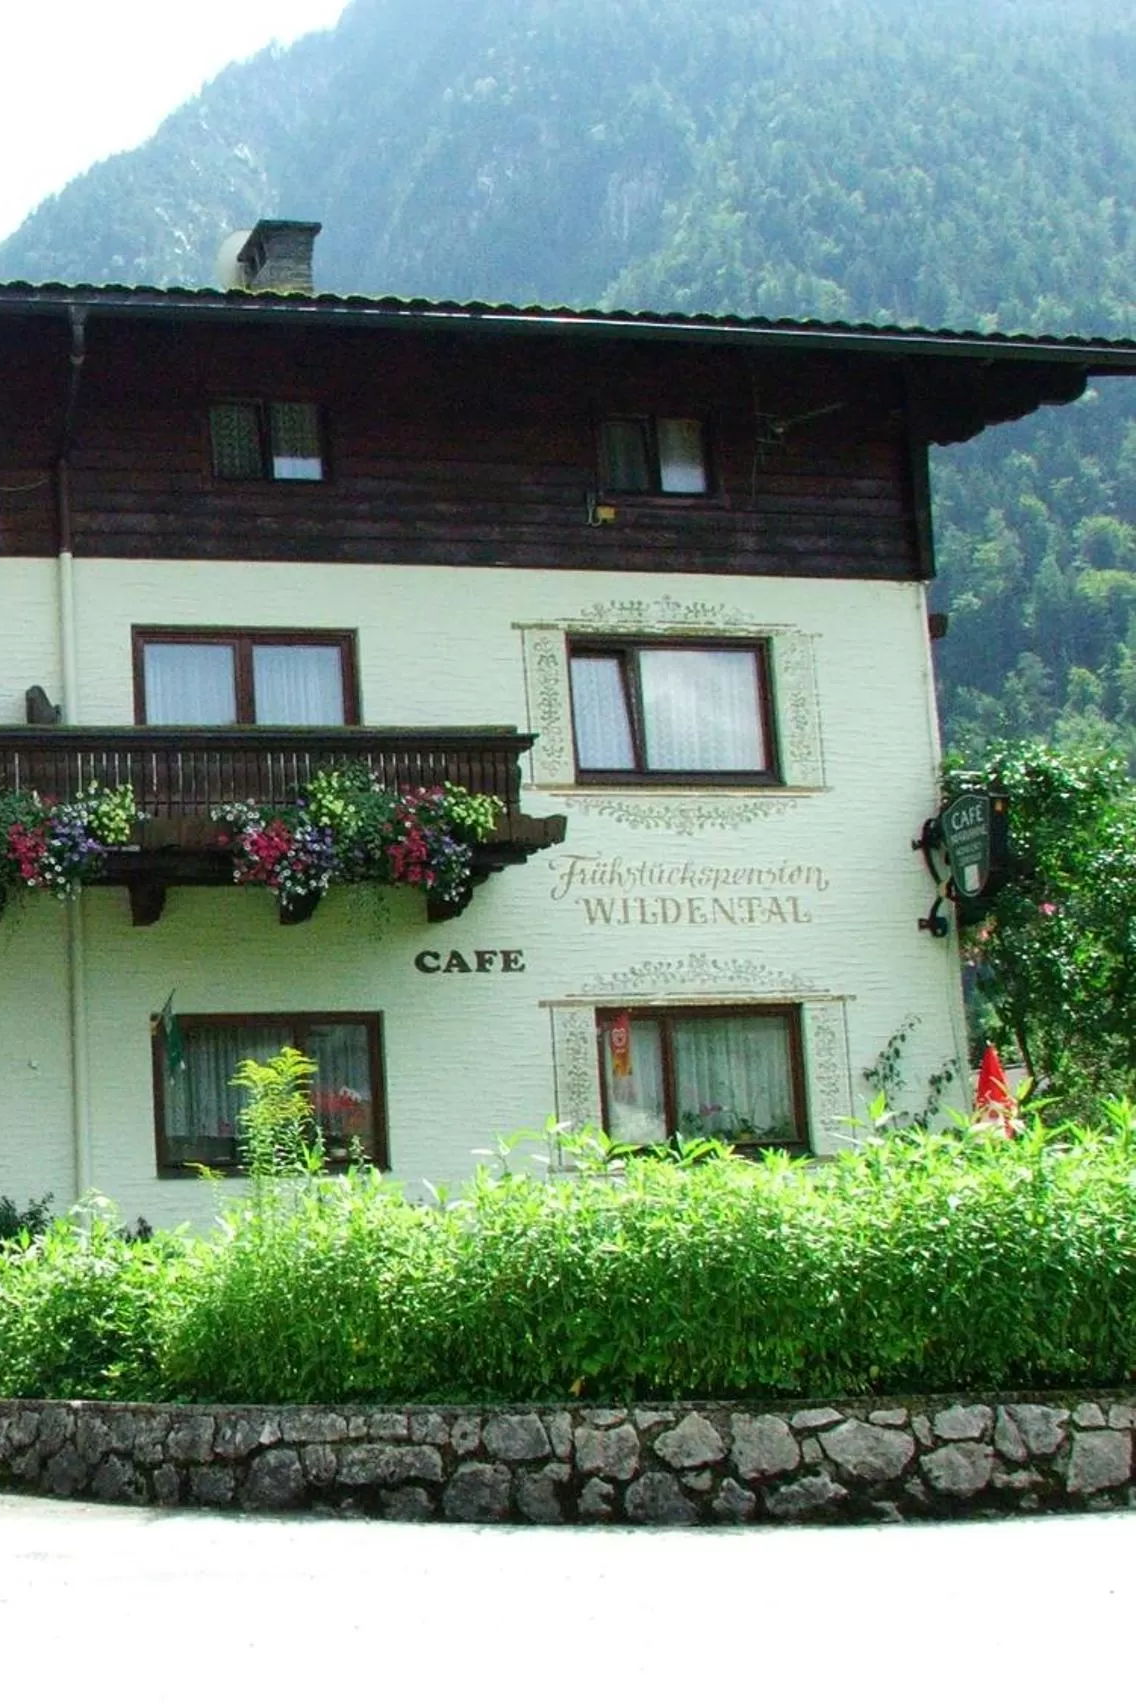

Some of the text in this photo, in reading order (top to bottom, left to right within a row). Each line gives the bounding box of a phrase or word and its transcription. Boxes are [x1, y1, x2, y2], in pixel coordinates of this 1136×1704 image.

[548, 852, 830, 900] Frühstückspension
[575, 896, 812, 925] WILDENTAL
[414, 949, 526, 973] CAFE
